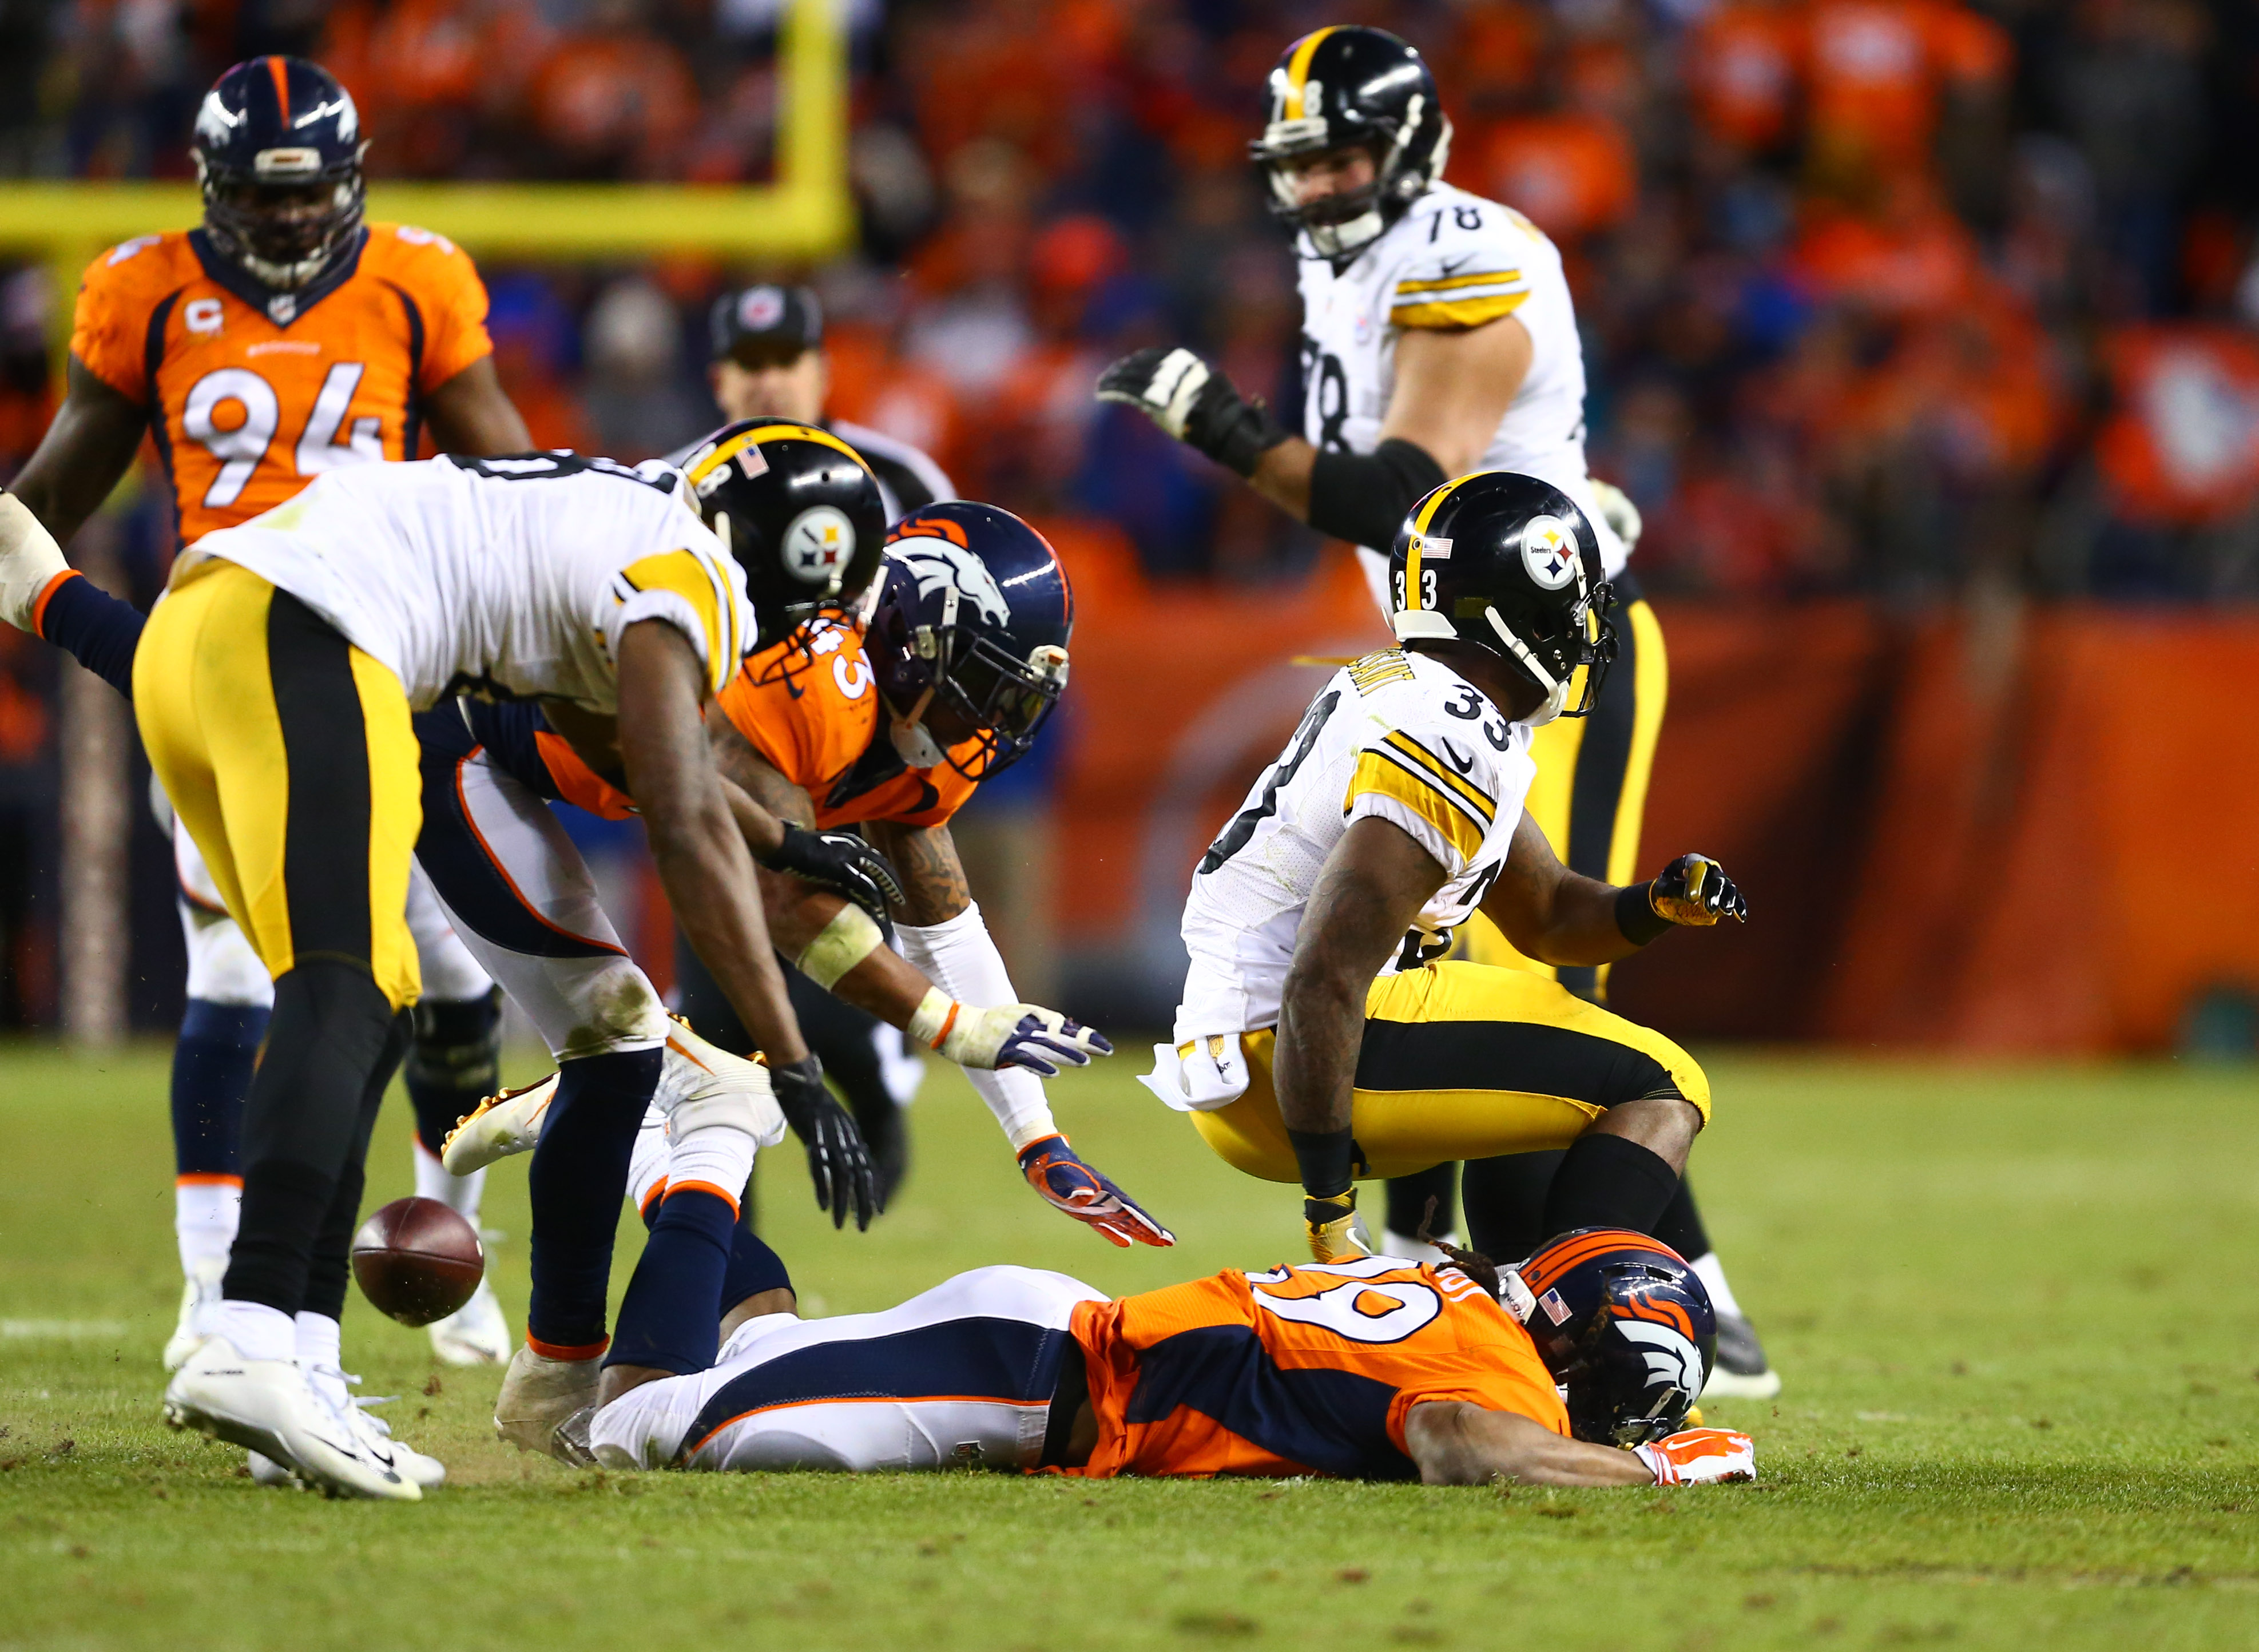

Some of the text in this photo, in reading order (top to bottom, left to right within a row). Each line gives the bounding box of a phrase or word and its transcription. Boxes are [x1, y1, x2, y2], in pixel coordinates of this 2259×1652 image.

[185, 299, 224, 332] C
[182, 362, 386, 509] 94
[1395, 569, 1436, 611] 33
[1445, 684, 1512, 752] 33
